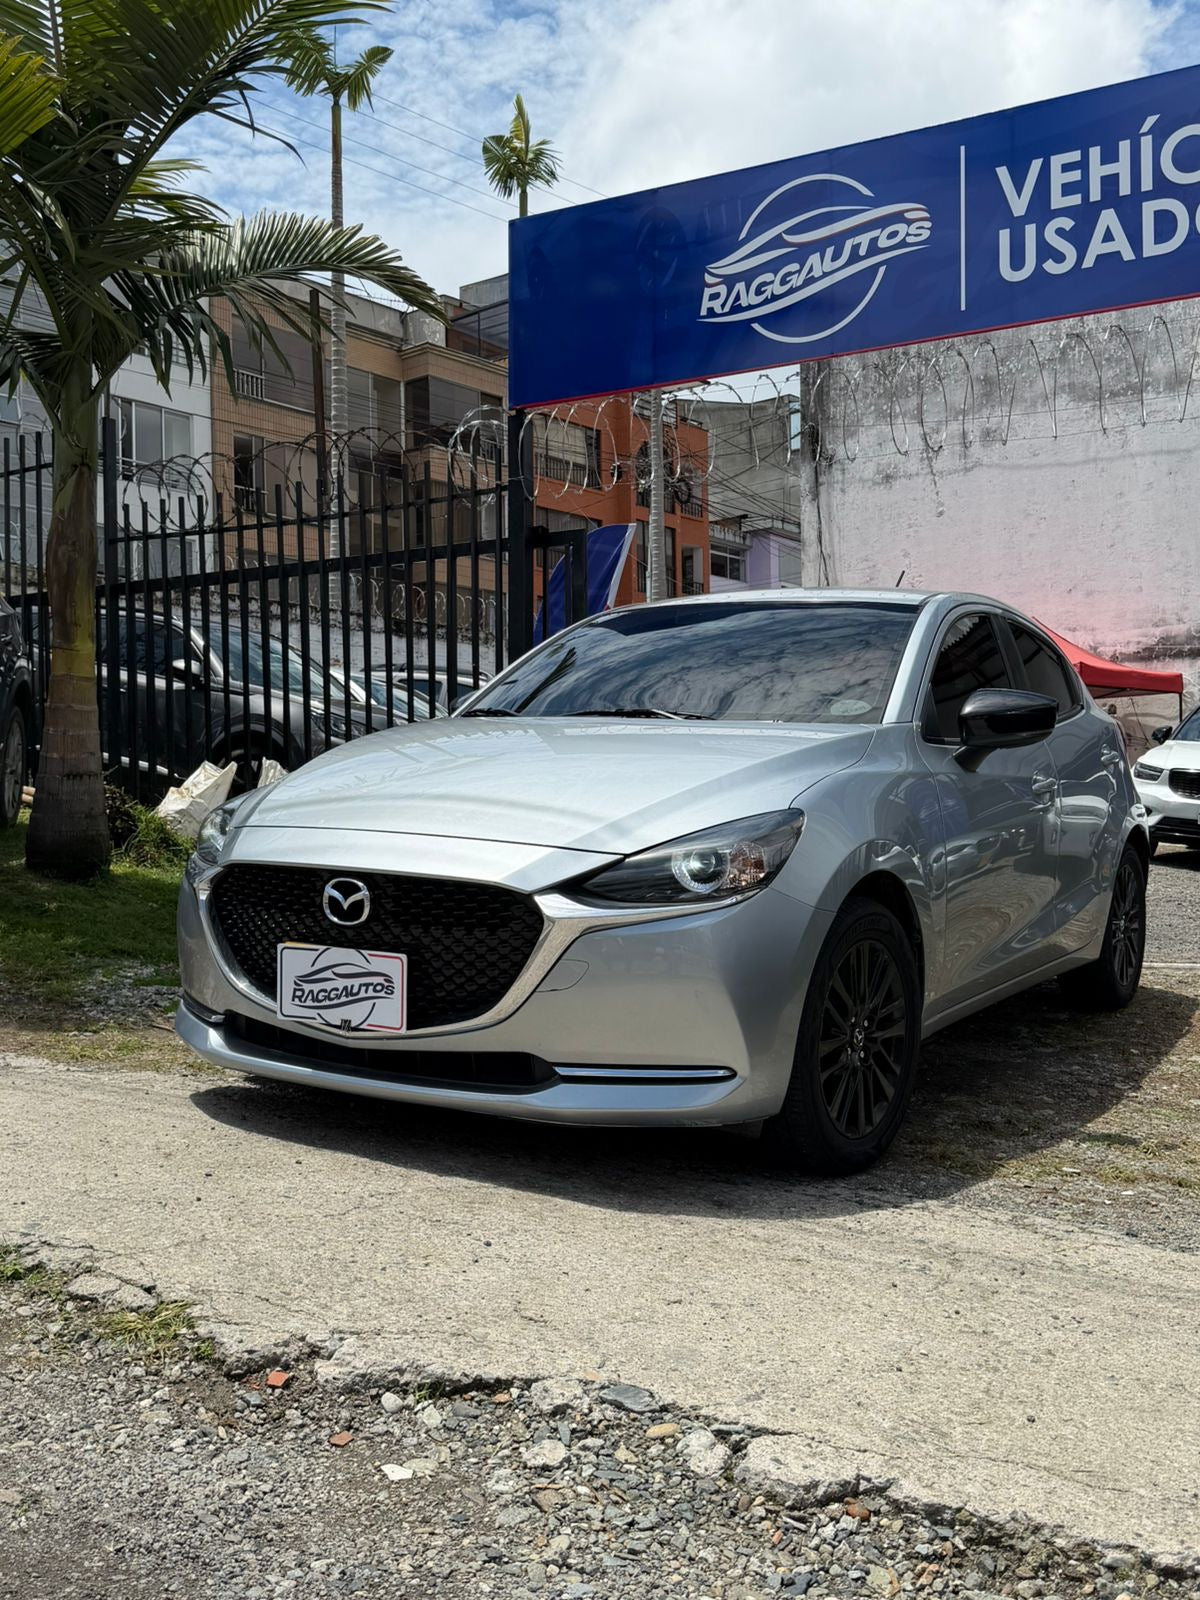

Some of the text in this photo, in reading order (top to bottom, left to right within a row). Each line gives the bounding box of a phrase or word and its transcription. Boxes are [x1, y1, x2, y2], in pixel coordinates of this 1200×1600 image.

[699, 220, 932, 316] RAGGAUTOS
[999, 198, 1200, 283] USAD
[291, 982, 396, 1004] RAGGAUTOS
